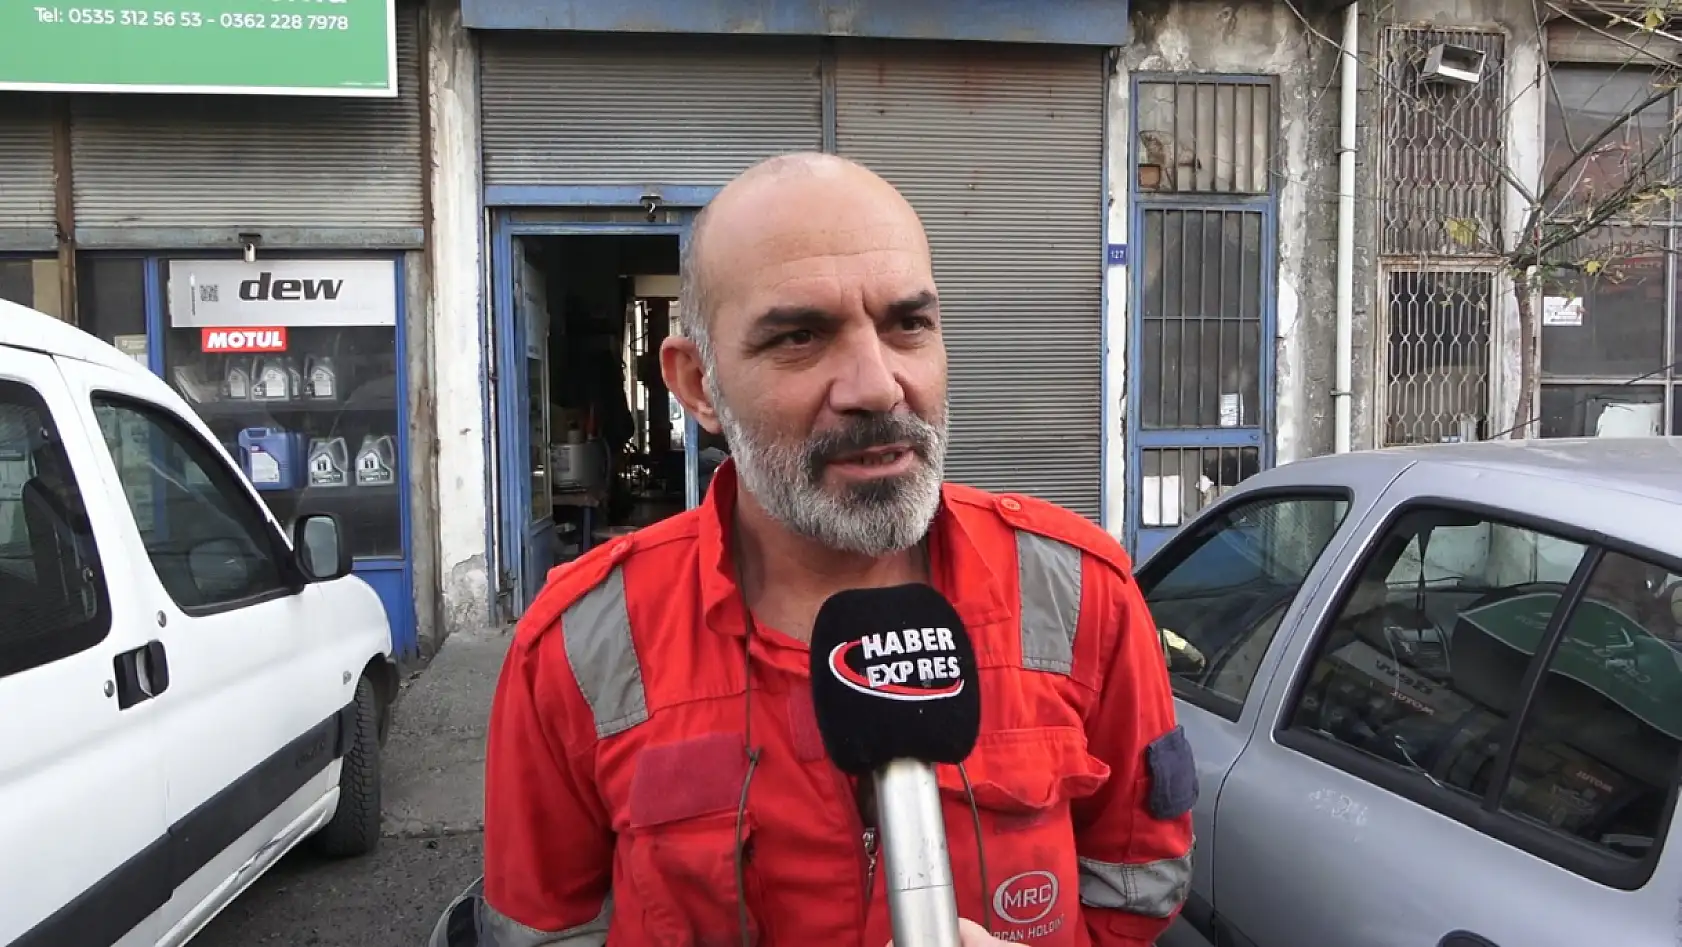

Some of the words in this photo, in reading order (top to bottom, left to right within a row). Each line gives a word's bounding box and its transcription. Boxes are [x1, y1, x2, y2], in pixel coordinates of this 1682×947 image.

[34, 6, 64, 23] Tel:
[68, 8, 116, 25] 0535
[119, 9, 149, 26] 312
[153, 11, 176, 27] 56
[179, 12, 203, 28] 53
[220, 13, 266, 29] 0362
[270, 14, 303, 30] 228
[306, 14, 349, 31] 7978
[238, 271, 345, 301] dew
[206, 330, 284, 349] MOTUL
[861, 627, 956, 660] HABER
[1003, 884, 1052, 910] MRC
